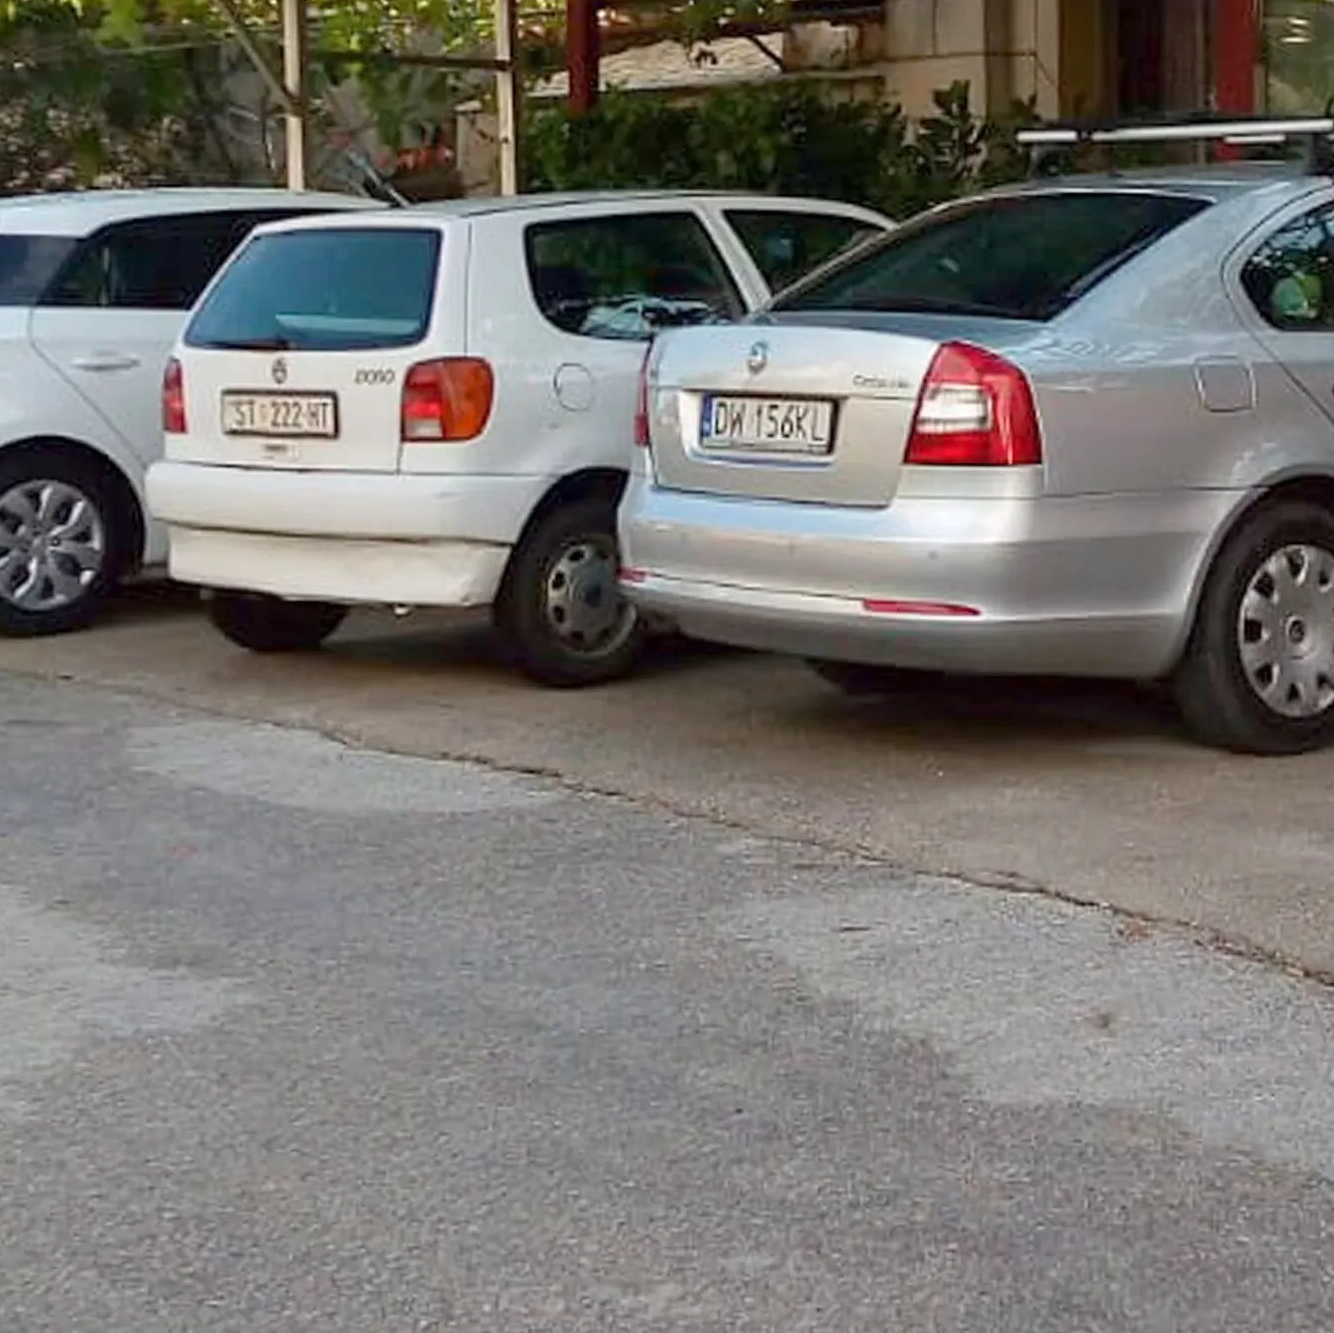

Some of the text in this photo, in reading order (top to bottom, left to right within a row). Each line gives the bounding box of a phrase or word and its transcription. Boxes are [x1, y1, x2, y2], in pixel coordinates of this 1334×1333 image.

[233, 399, 254, 427] ST
[714, 401, 824, 442] DW 156KL
